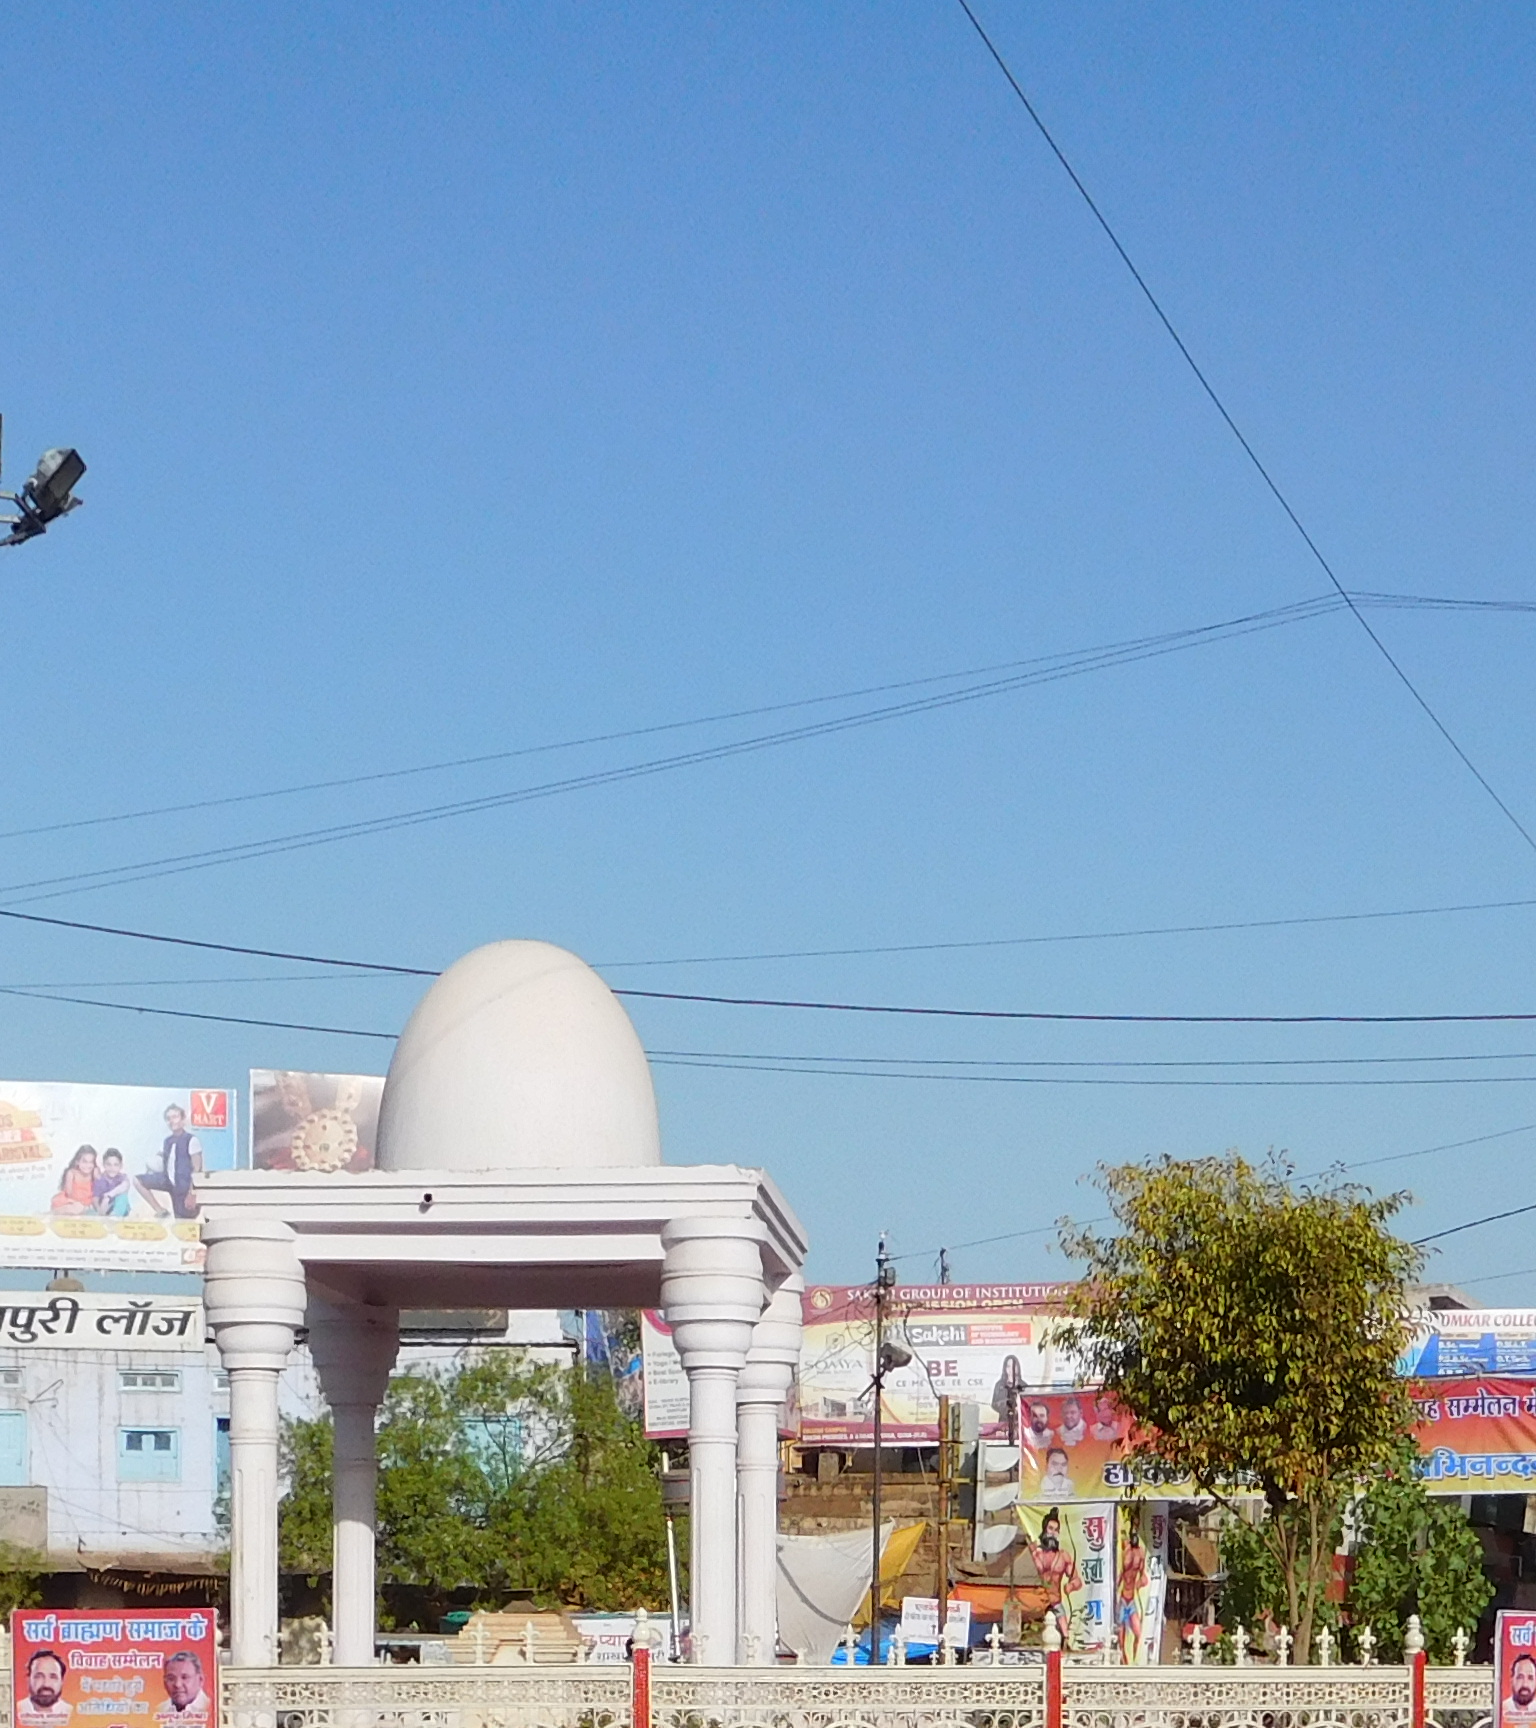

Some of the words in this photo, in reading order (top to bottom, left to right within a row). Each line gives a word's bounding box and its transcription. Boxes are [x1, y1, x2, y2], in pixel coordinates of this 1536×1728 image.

[198, 1093, 219, 1114] V
[194, 1113, 225, 1126] MART
[900, 1287, 950, 1300] GROUP
[954, 1287, 971, 1299] OF
[96, 1300, 196, 1336] लॉज
[1441, 1313, 1491, 1328] OMKAR
[911, 1326, 965, 1345] Sakshi
[927, 1359, 959, 1377] BE
[1445, 1387, 1519, 1417] सम्मेलन
[24, 1615, 56, 1641] सर्व
[61, 1619, 121, 1642] ब्राह्मण
[126, 1619, 183, 1641] समाज
[186, 1614, 208, 1640] के
[1510, 1621, 1534, 1645] सर्व
[70, 1649, 111, 1669] विवाह
[112, 1651, 163, 1669] सम्मेलन
